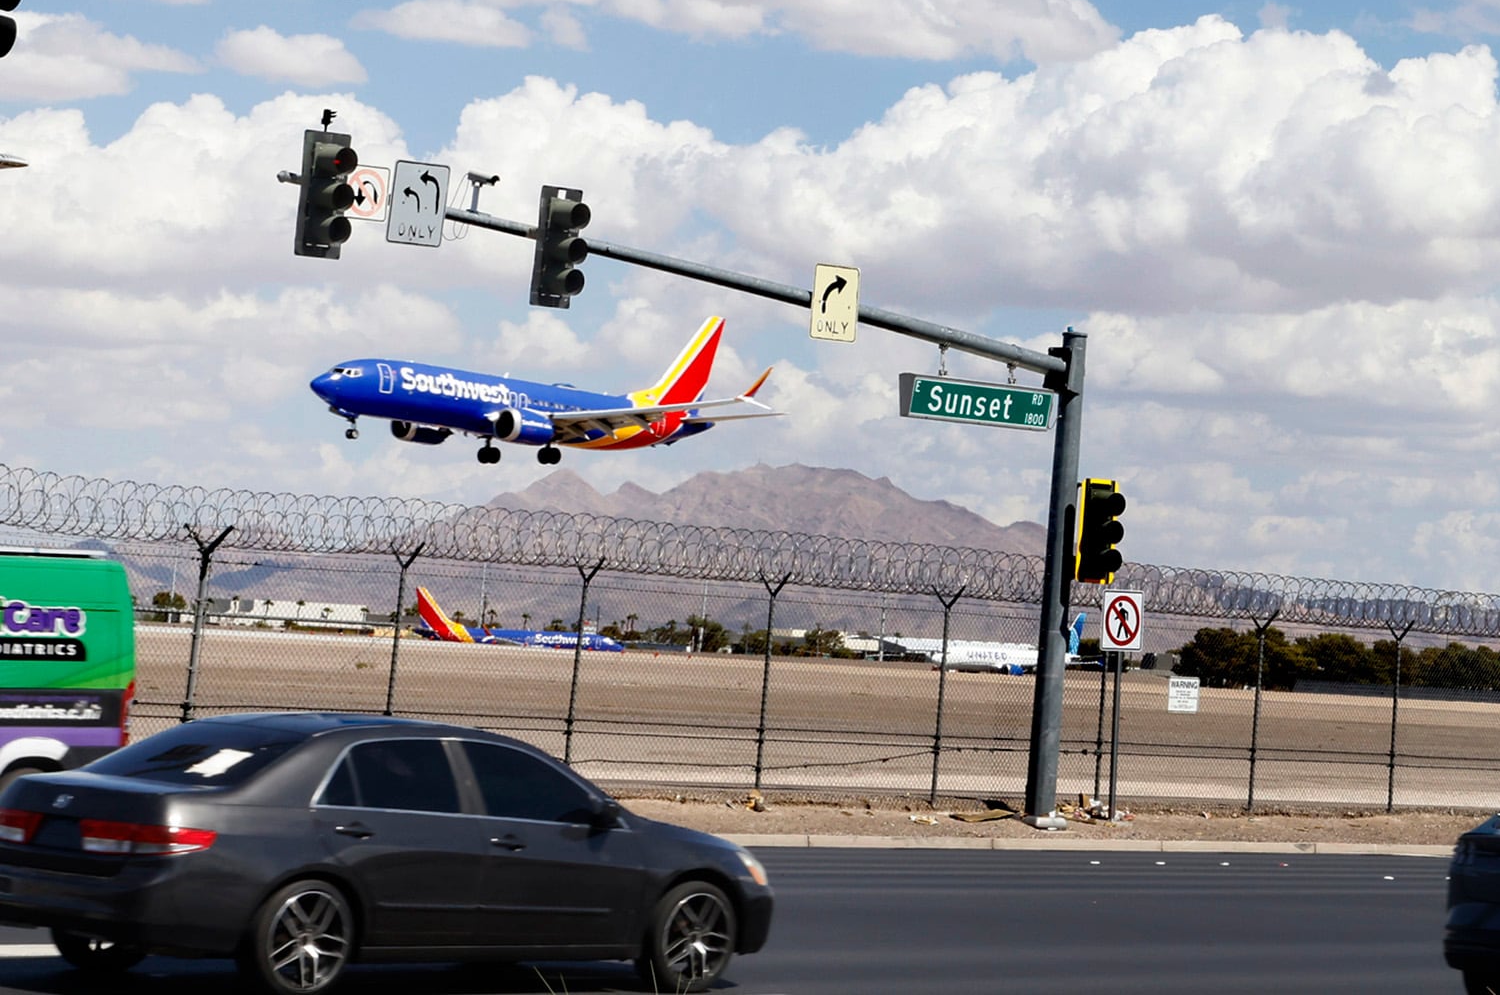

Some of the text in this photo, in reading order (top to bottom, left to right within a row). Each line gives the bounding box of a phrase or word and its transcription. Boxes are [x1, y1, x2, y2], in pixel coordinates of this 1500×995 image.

[398, 223, 436, 239] ONLY
[817, 319, 849, 335] ONLY
[400, 366, 510, 405] Southwest
[914, 380, 922, 393] E
[927, 385, 1013, 420] Sunset
[1031, 393, 1044, 406] RD
[1024, 412, 1044, 426] 1800
[3, 601, 82, 634] Care
[534, 633, 591, 645] Southwst
[966, 650, 1008, 661] UNITED
